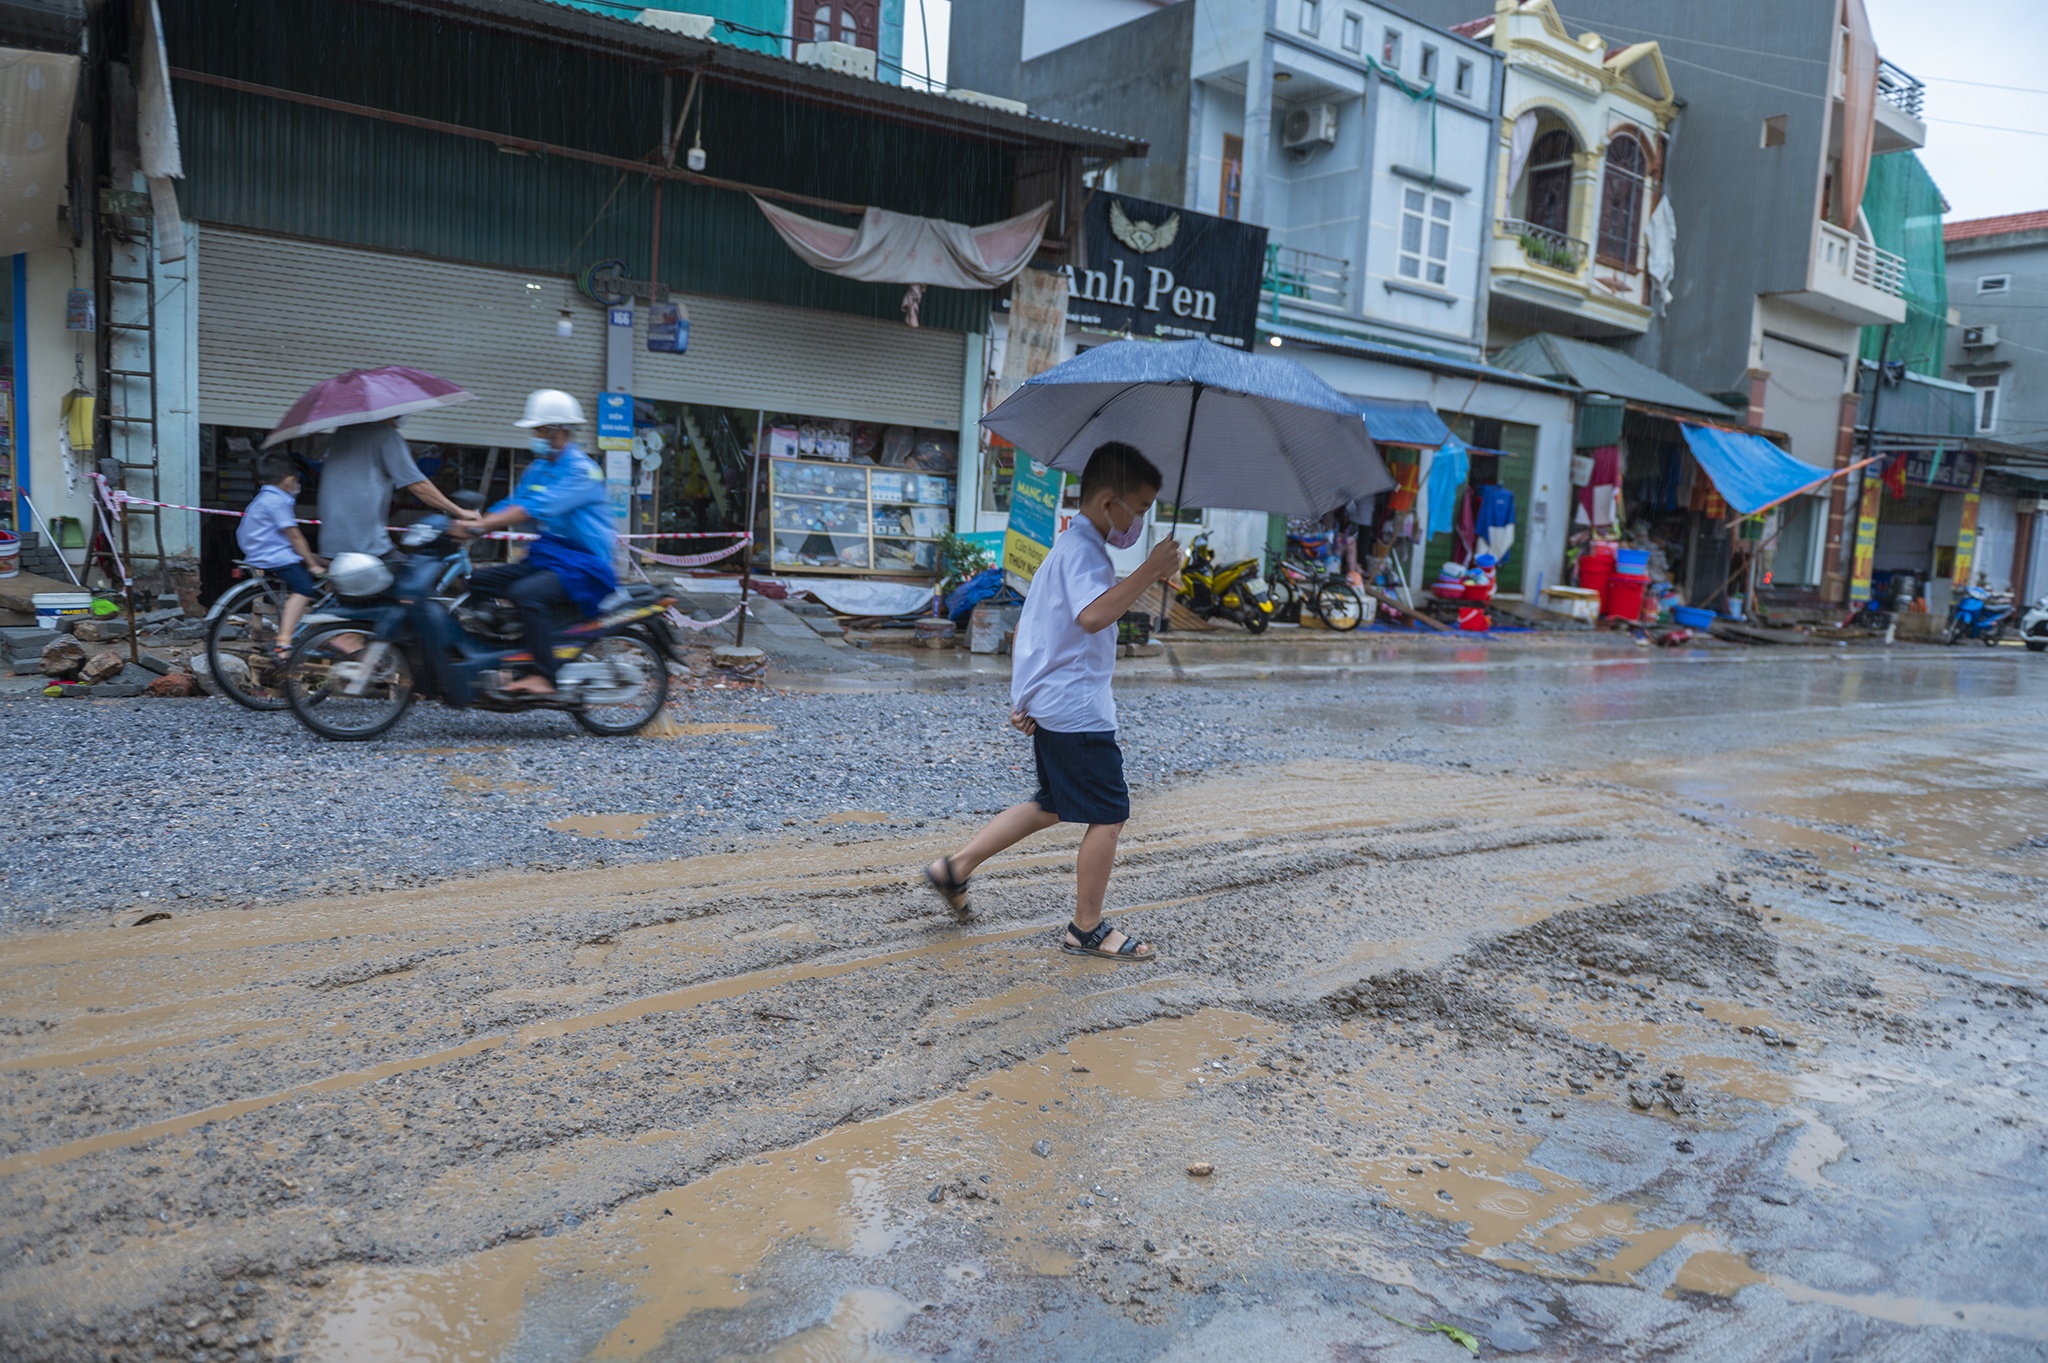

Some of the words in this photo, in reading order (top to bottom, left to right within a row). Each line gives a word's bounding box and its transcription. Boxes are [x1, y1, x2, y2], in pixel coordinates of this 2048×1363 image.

[1056, 258, 1135, 307] Anh
[1143, 265, 1216, 321] Pen
[613, 311, 631, 325] 166
